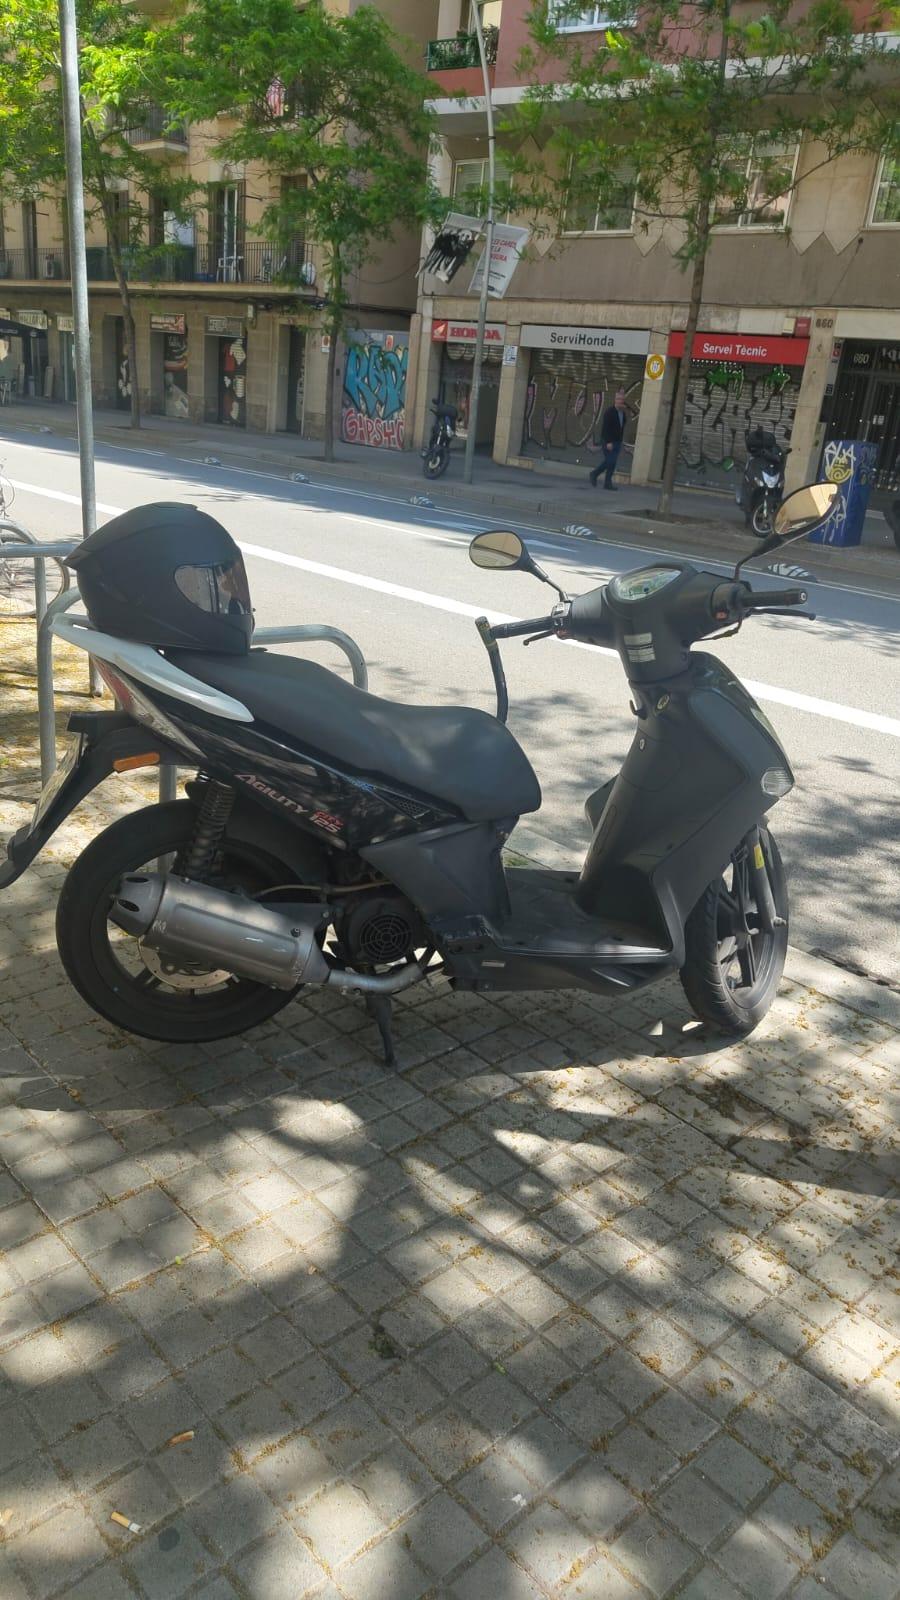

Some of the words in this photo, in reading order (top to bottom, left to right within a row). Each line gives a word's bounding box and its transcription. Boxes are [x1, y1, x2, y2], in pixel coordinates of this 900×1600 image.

[450, 327, 502, 340] HONDA
[550, 332, 615, 347] ServiHonda
[702, 343, 732, 355] Servei
[735, 344, 768, 357] Tècnic
[234, 774, 309, 814] AGILITY
[309, 815, 341, 834] 125
